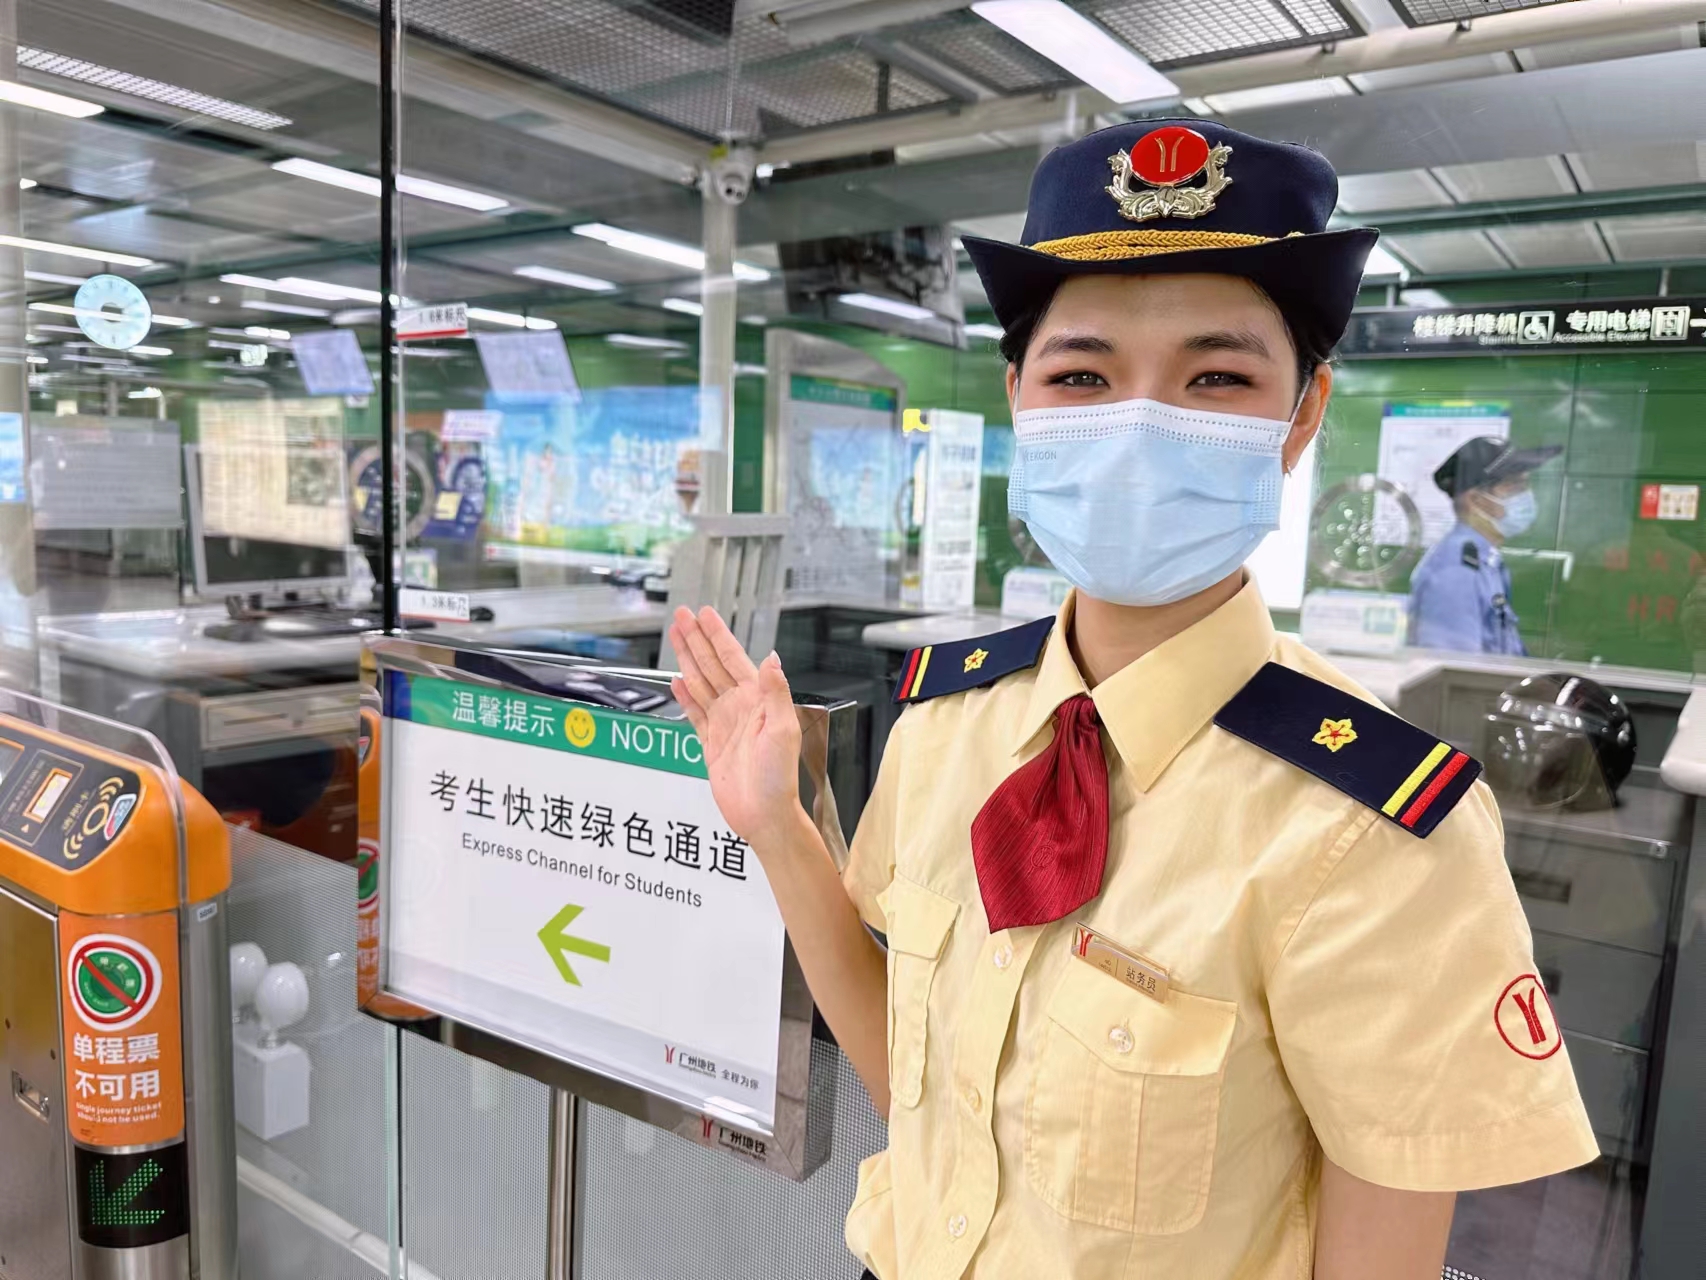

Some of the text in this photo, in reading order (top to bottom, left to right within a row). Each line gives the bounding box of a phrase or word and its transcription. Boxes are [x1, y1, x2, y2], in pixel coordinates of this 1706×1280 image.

[1565, 308, 1651, 332] 专用电梯
[452, 690, 702, 763] 温馨提示 NOTIC
[430, 770, 749, 881] 考生快速绿色通道
[462, 833, 702, 907] Express Channel for Students
[1126, 966, 1156, 992] 站务员
[73, 1032, 161, 1065] 单程票
[679, 1052, 717, 1073] 广州地铁
[75, 1069, 160, 1101] 不可用
[96, 1106, 131, 1116] journey
[102, 1115, 117, 1124] not
[719, 1127, 767, 1156] 广州地铁
